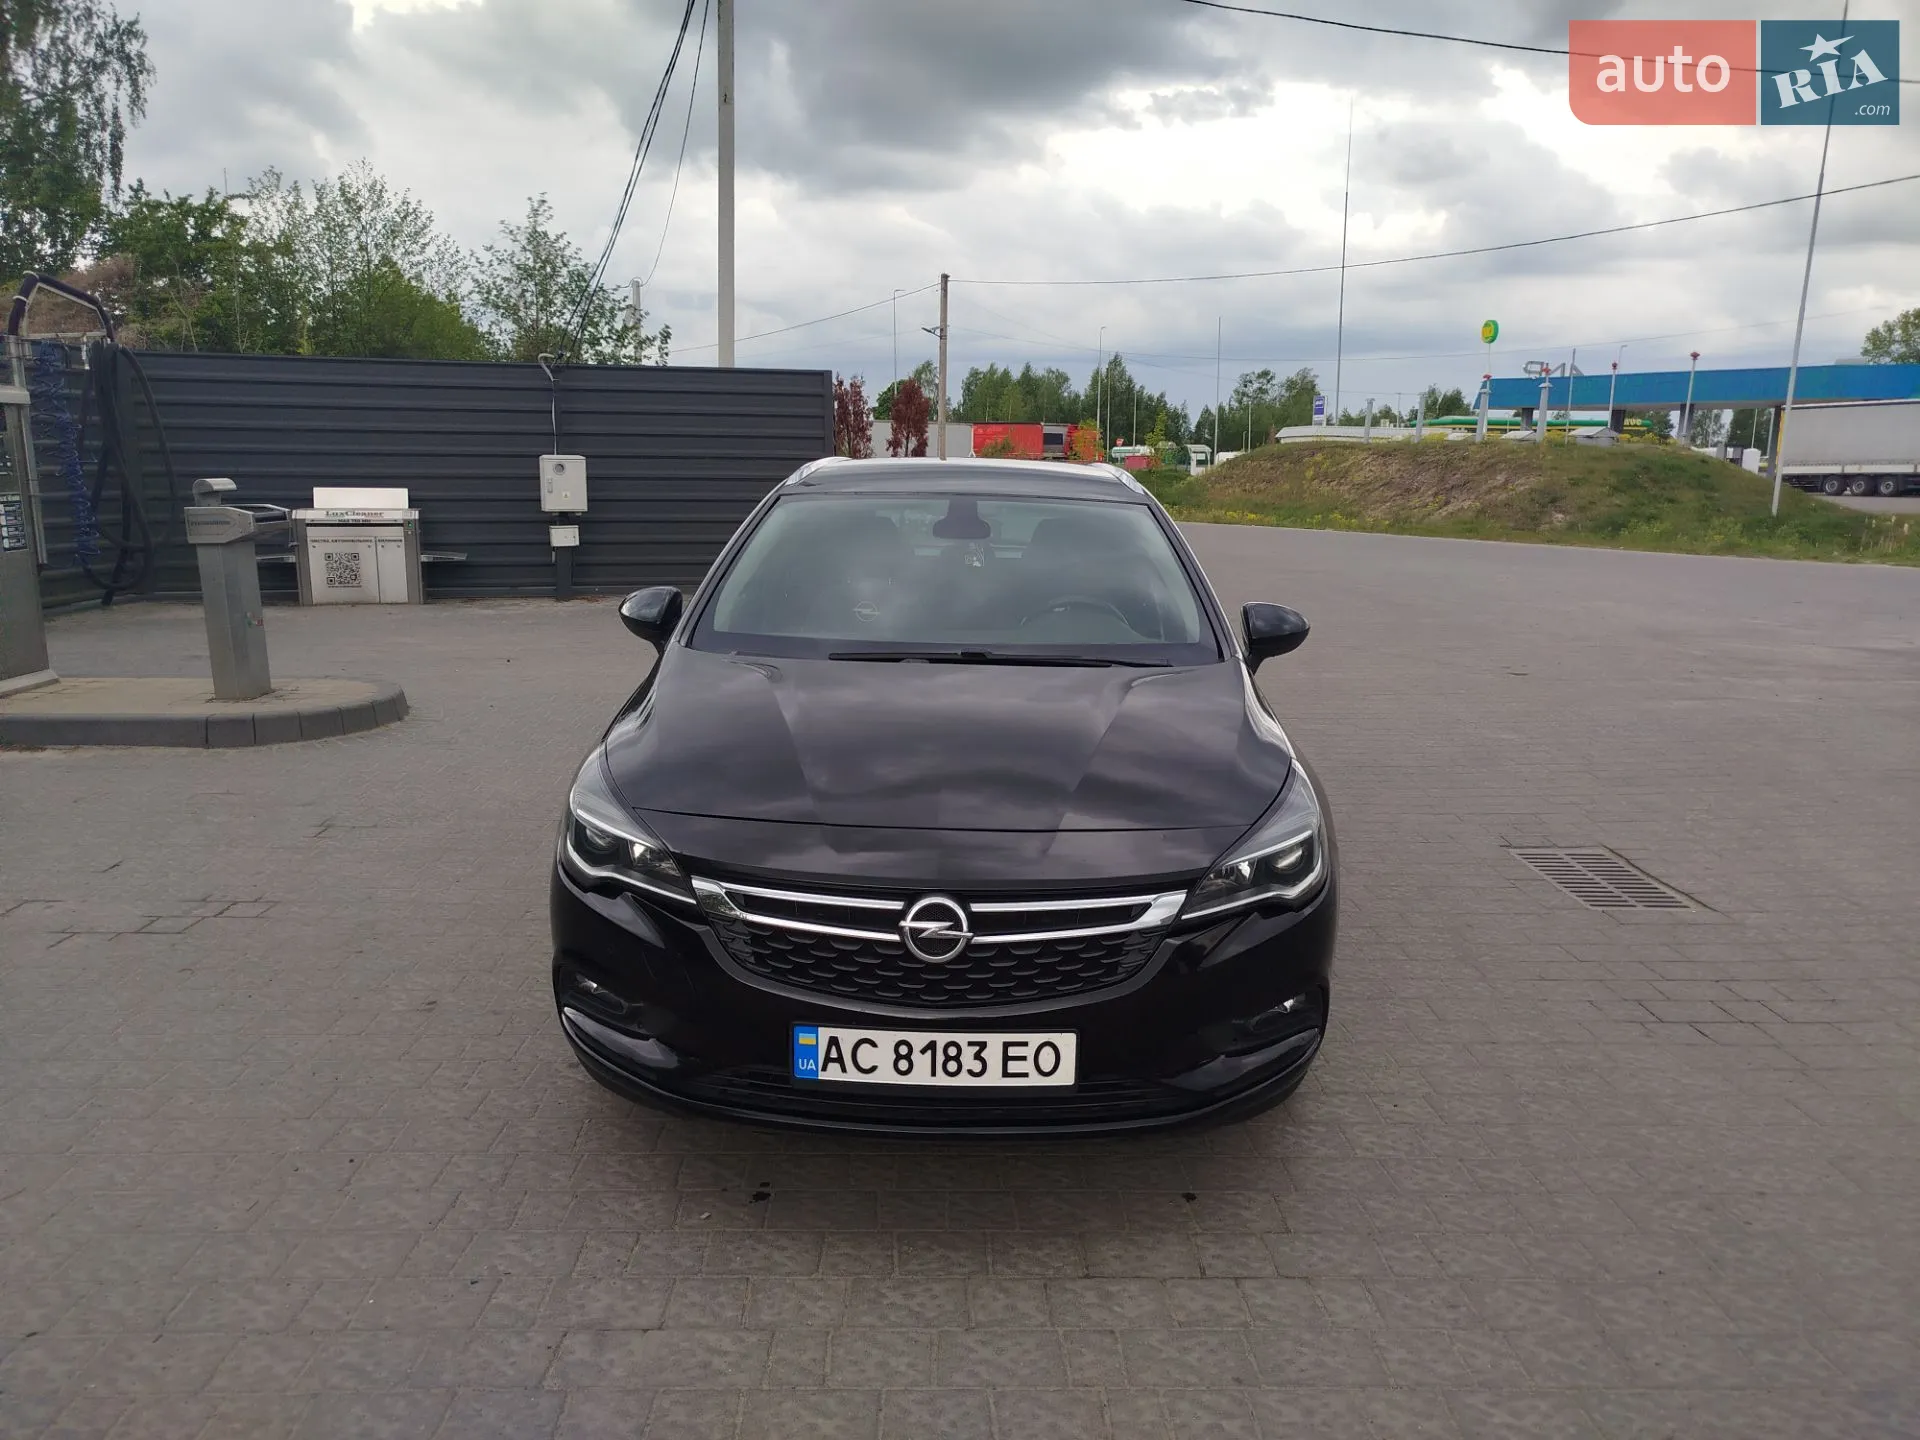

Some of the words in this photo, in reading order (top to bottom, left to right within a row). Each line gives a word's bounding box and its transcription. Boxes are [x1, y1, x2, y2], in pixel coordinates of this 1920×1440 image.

[798, 1058, 817, 1071] UA
[820, 1035, 879, 1075] AC
[892, 1039, 988, 1078] 8183
[1001, 1040, 1061, 1078] EO
